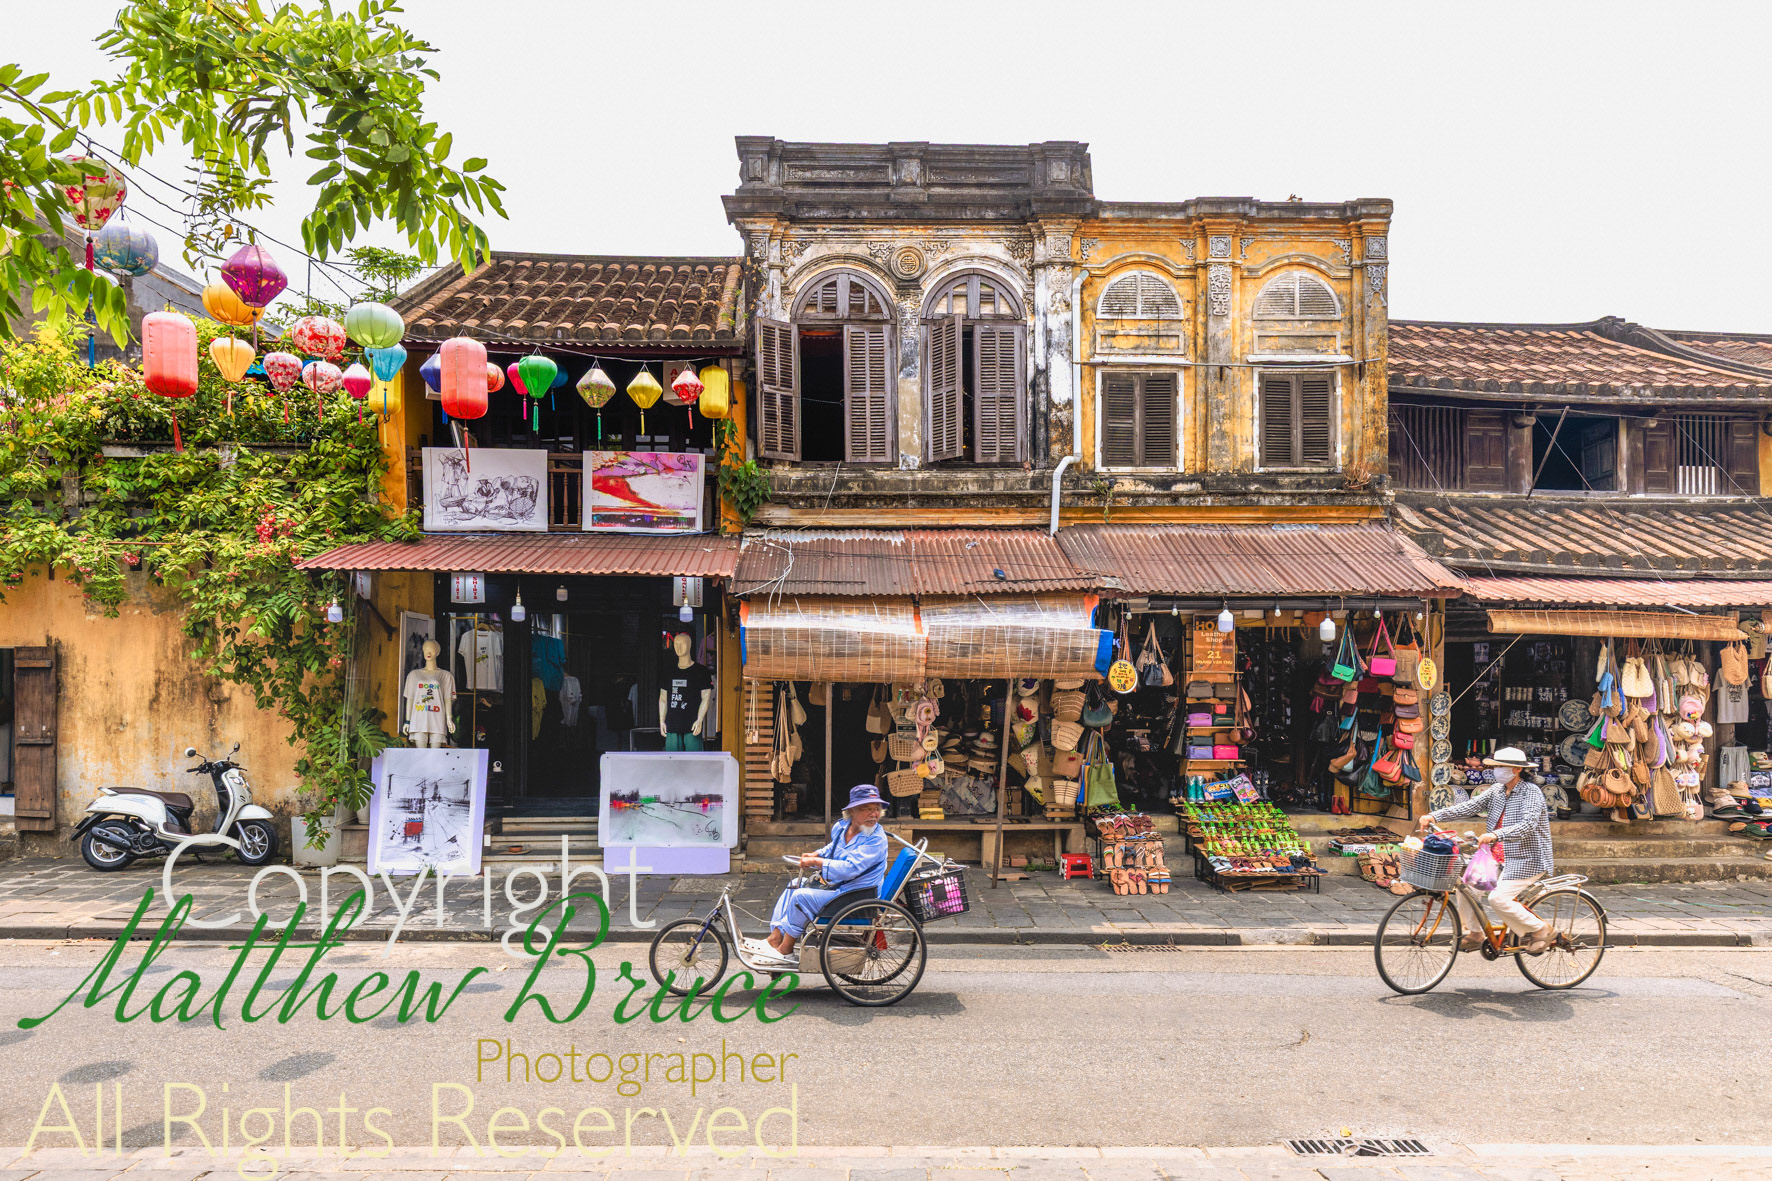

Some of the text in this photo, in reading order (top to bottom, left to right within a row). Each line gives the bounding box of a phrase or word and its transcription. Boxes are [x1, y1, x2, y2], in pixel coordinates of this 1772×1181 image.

[1207, 650, 1222, 659] 21
[426, 688, 433, 696] 2
[415, 703, 441, 713] WILD
